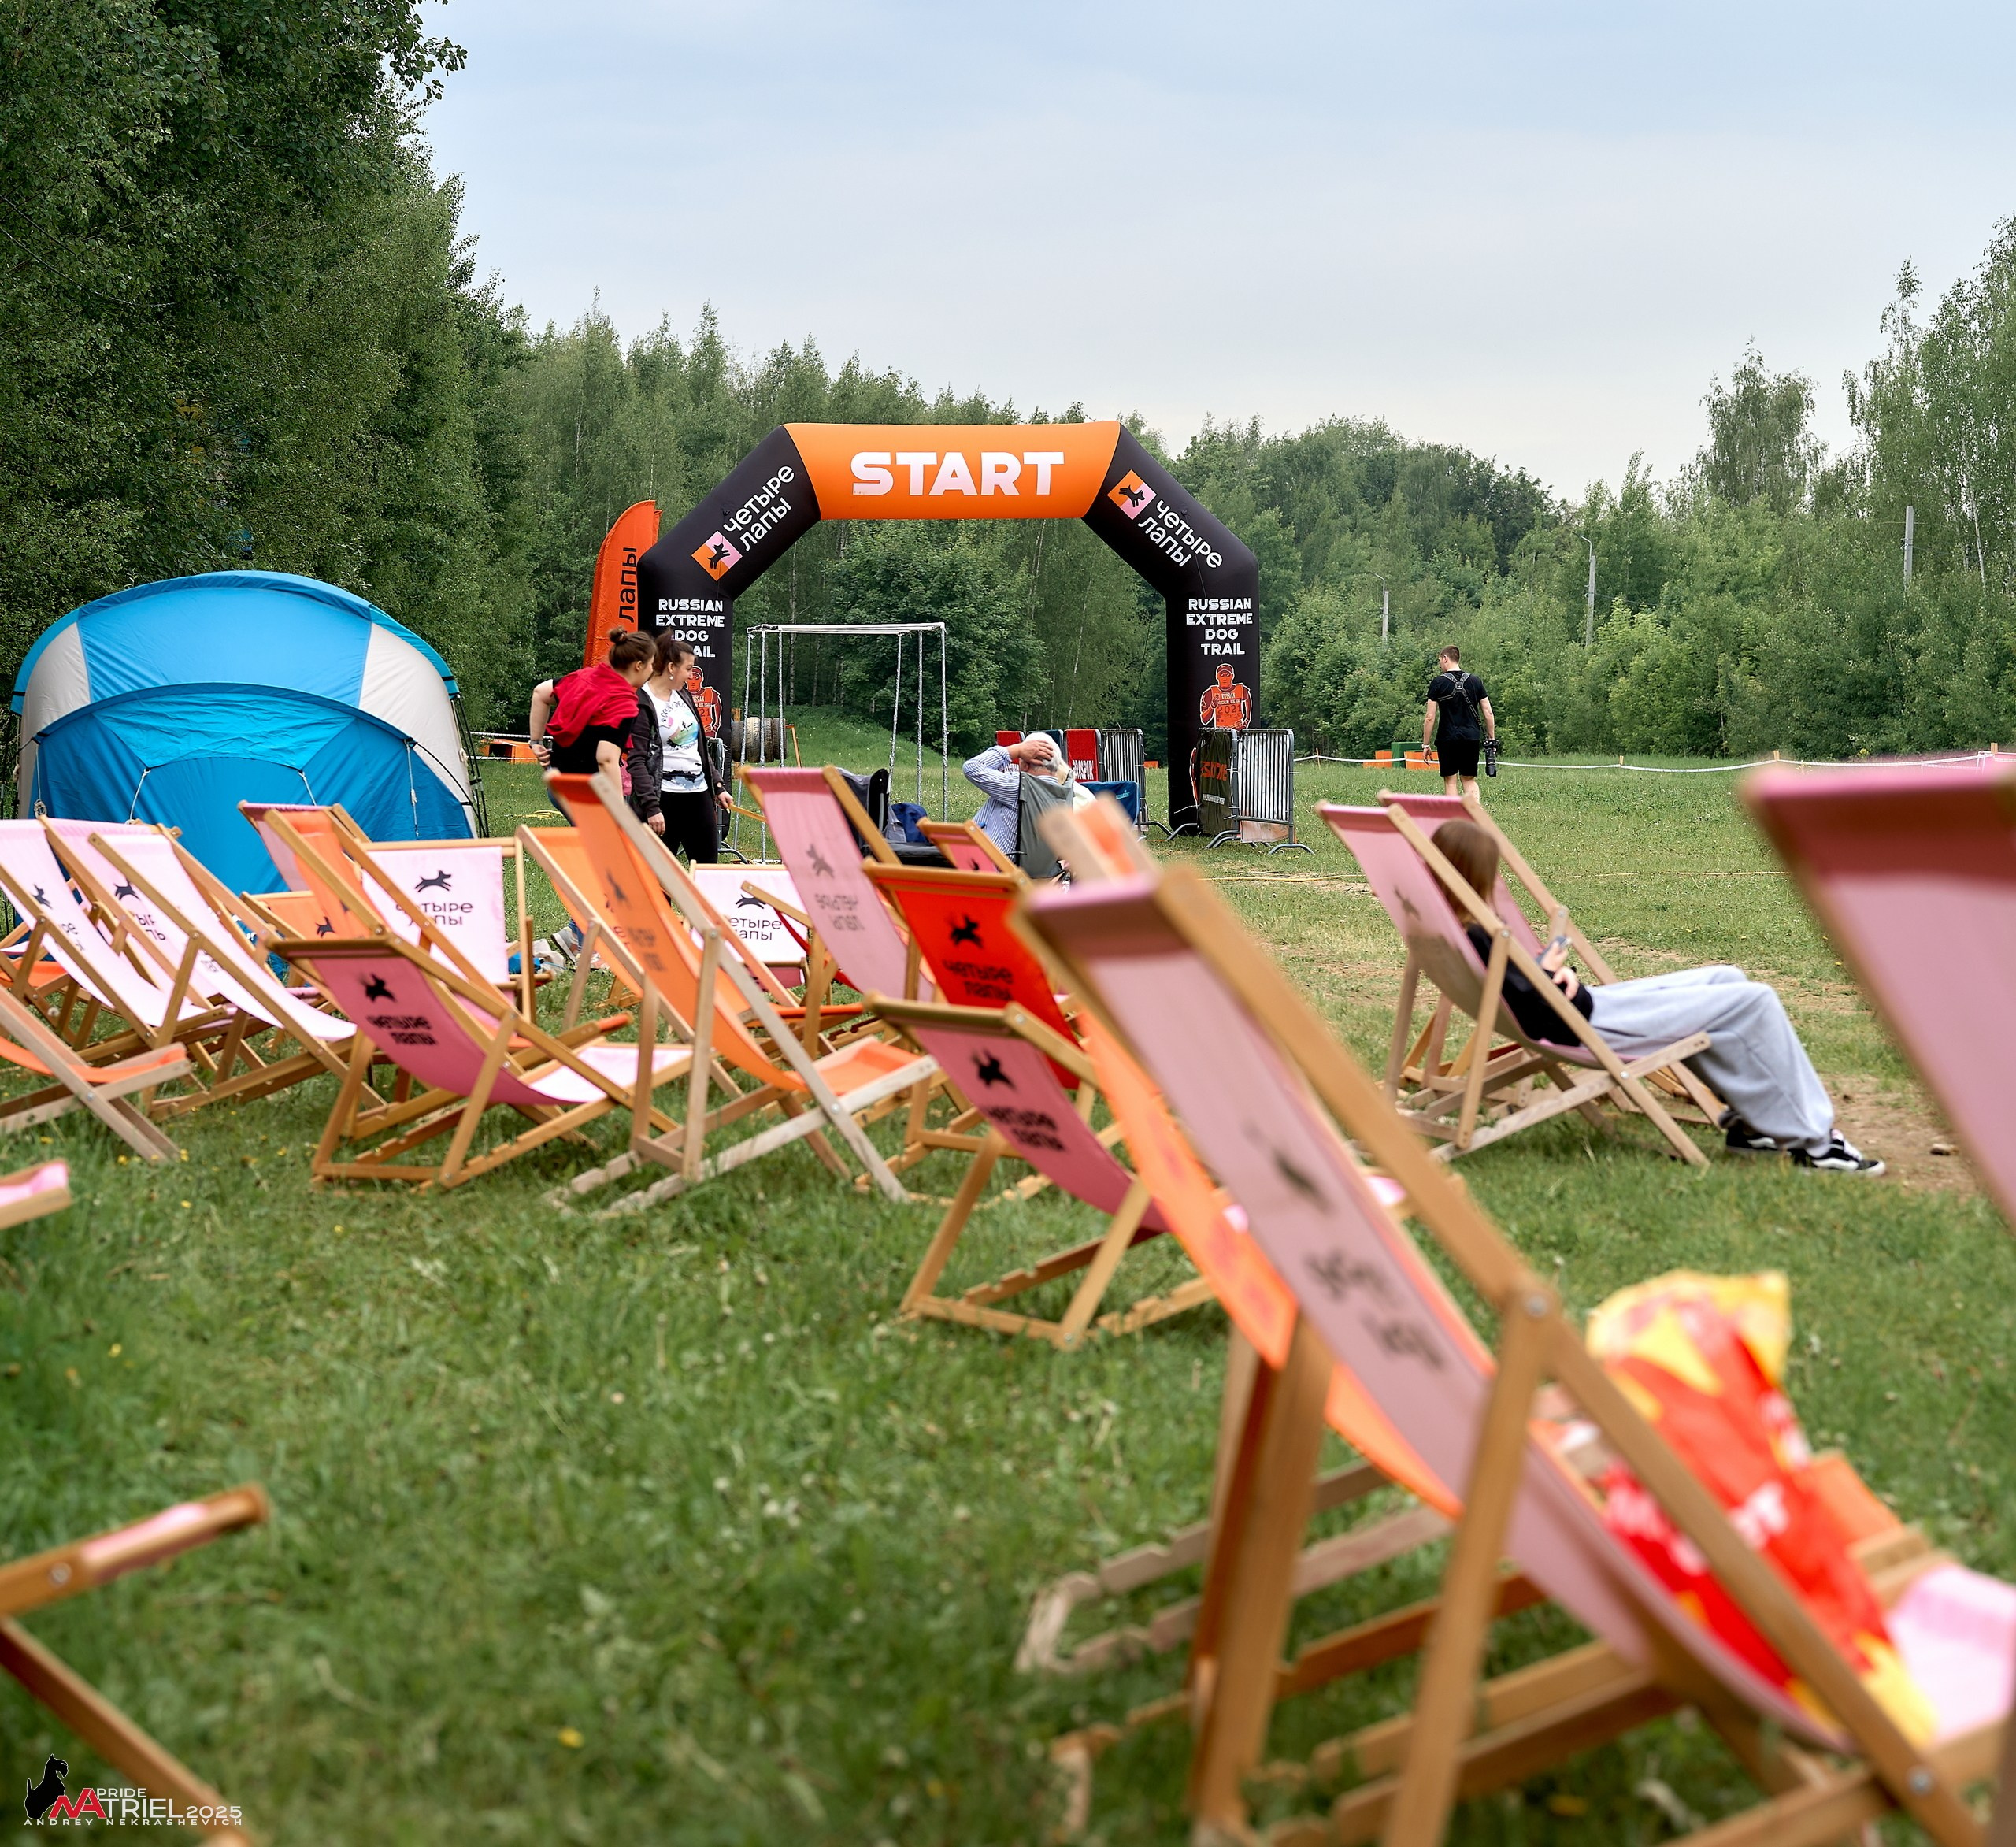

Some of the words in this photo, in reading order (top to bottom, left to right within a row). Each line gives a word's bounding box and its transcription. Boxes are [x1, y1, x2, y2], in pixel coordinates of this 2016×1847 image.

[850, 451, 1064, 496] START
[723, 465, 795, 532] четыре
[739, 497, 792, 551] лапы
[1156, 499, 1223, 568] четыре
[1137, 517, 1192, 567] лапы
[619, 547, 637, 623] лапы
[658, 599, 723, 612] RUSSIAN
[1188, 598, 1251, 610] RUSSIAN
[656, 614, 724, 628] EXTREME
[1186, 613, 1253, 625] EXTREME
[674, 629, 709, 642] DOG
[1205, 628, 1239, 640] DOG
[693, 645, 716, 658] AIL
[1200, 643, 1245, 655] TRAIL
[729, 917, 782, 930] етыре
[737, 929, 773, 940] апы
